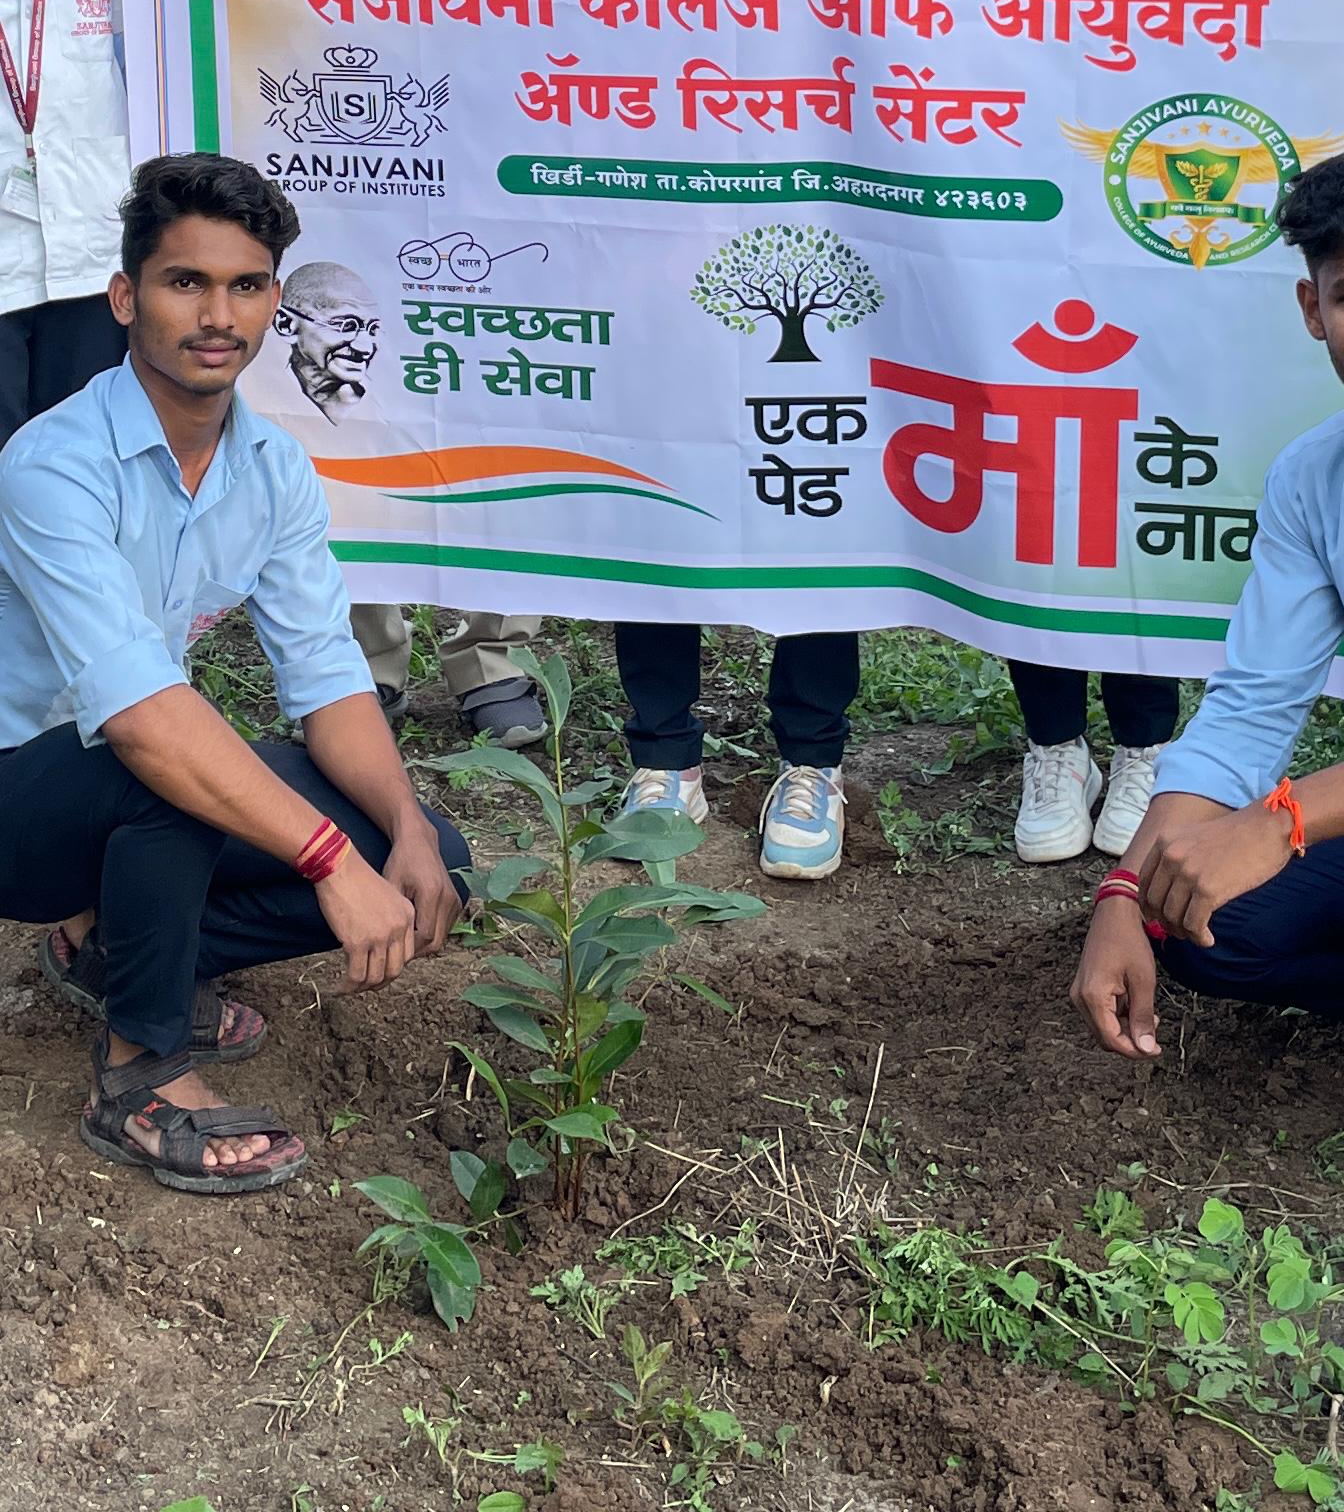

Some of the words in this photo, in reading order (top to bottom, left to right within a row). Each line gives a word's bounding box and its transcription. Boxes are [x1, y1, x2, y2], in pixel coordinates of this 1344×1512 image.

[344, 94, 365, 117] S
[676, 56, 855, 134] रिसर्च
[872, 64, 1026, 147] सेंटर
[1110, 98, 1198, 165] SANJIVANI
[1203, 99, 1295, 171] AYURVEDA
[266, 153, 444, 181] SANJIVANI
[282, 179, 328, 192] ROUP
[333, 180, 356, 193] OF
[362, 182, 446, 197] INSTITUTES
[934, 188, 1027, 211] ४२३६०३
[457, 258, 481, 268] भारत
[401, 299, 615, 345] स्वच्छता
[400, 341, 464, 394] ही
[479, 347, 596, 401] सेवा
[745, 395, 867, 445] एक
[1133, 415, 1218, 489] के
[748, 453, 850, 517] पेड
